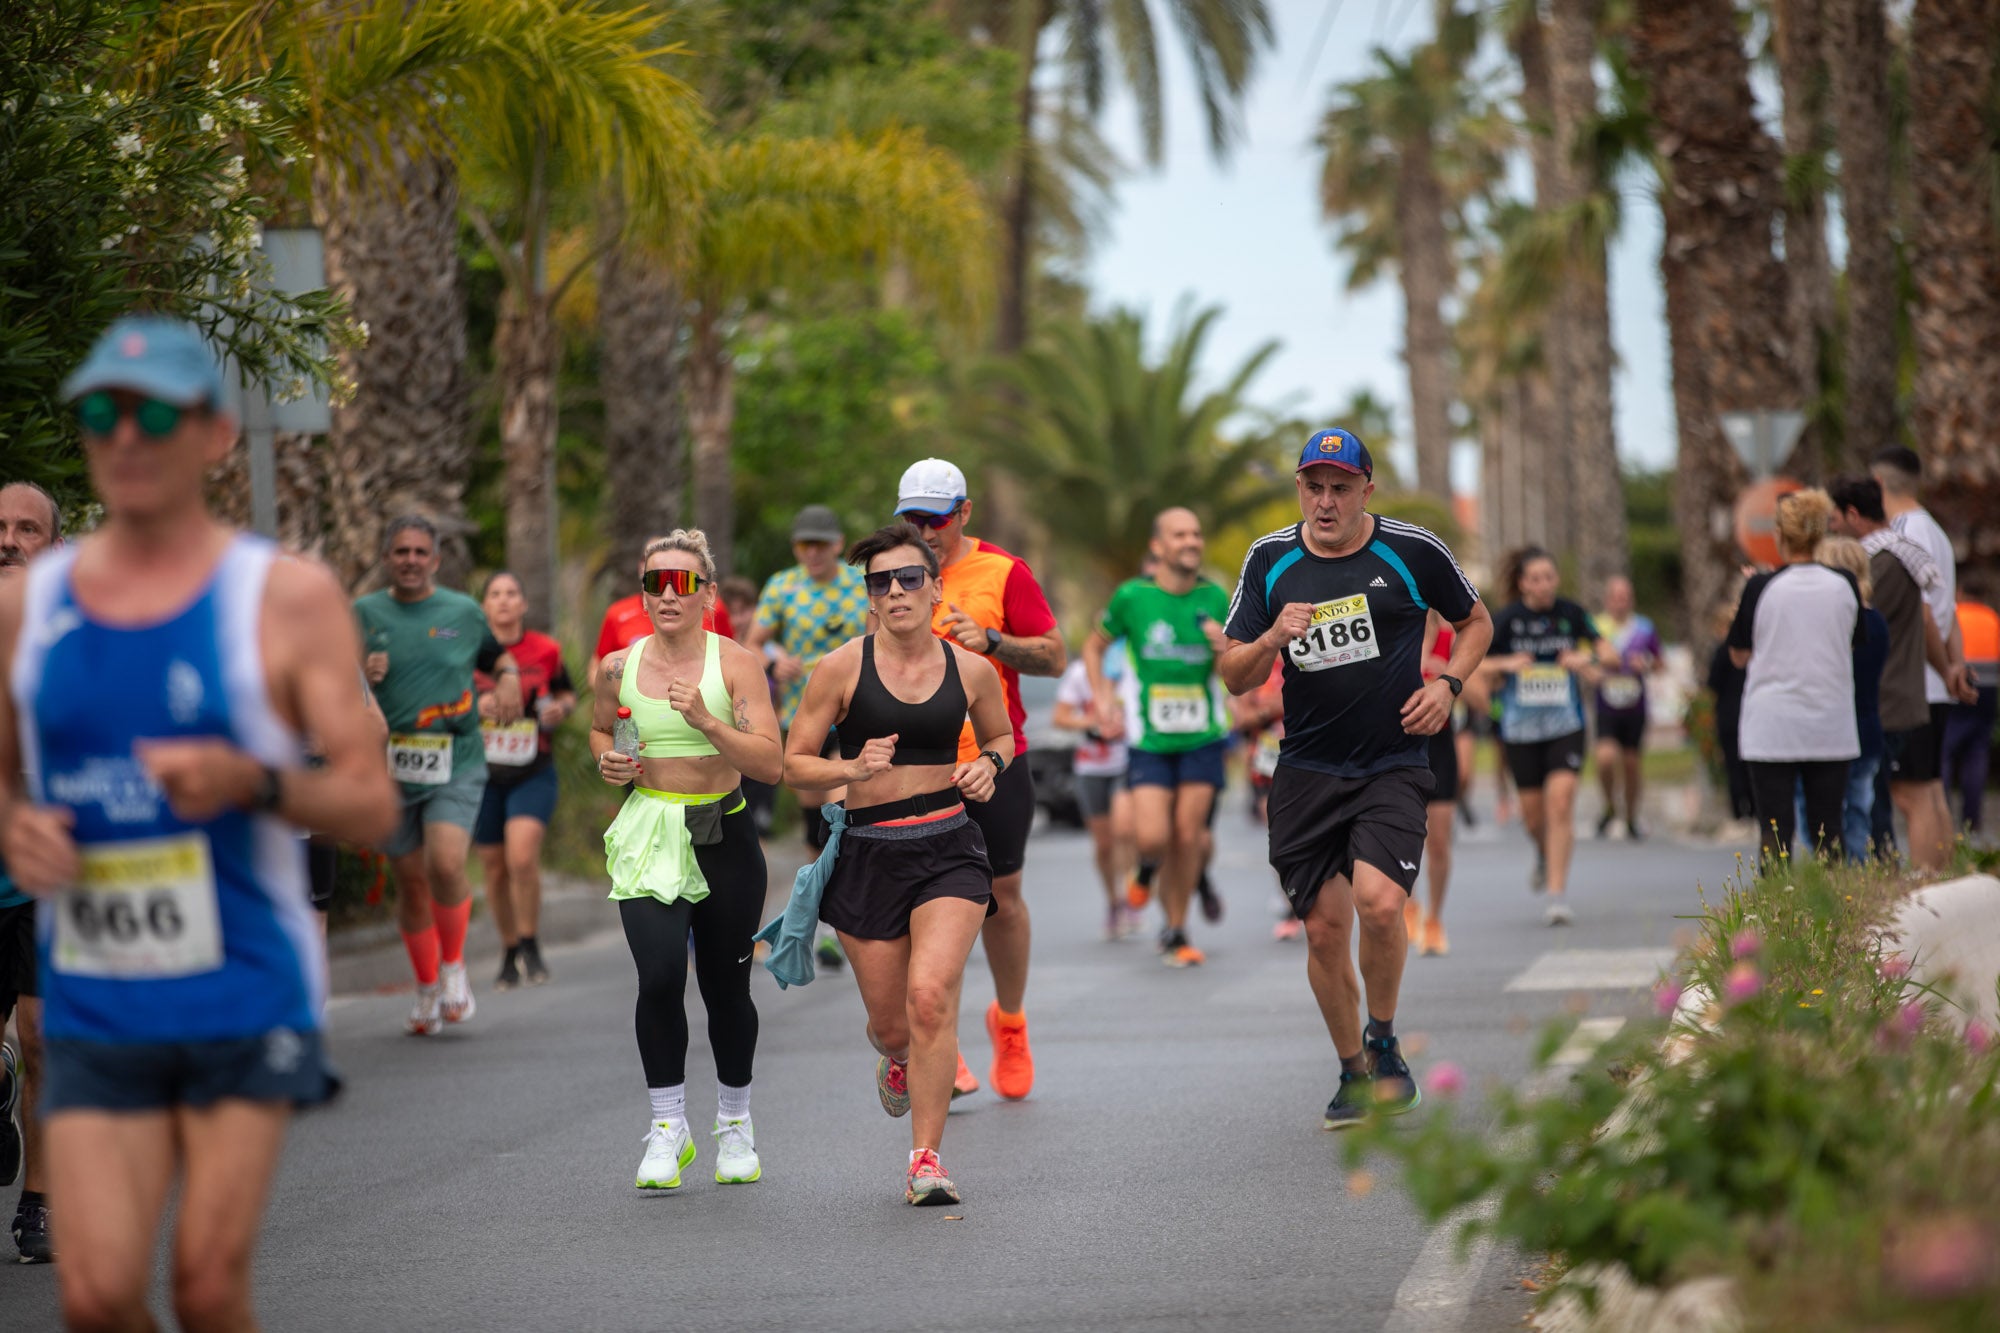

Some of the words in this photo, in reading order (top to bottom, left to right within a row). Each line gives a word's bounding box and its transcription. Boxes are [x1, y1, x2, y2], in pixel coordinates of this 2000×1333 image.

[1312, 605, 1350, 620] ONDO
[1292, 618, 1371, 657] 3186
[395, 751, 439, 771] 692
